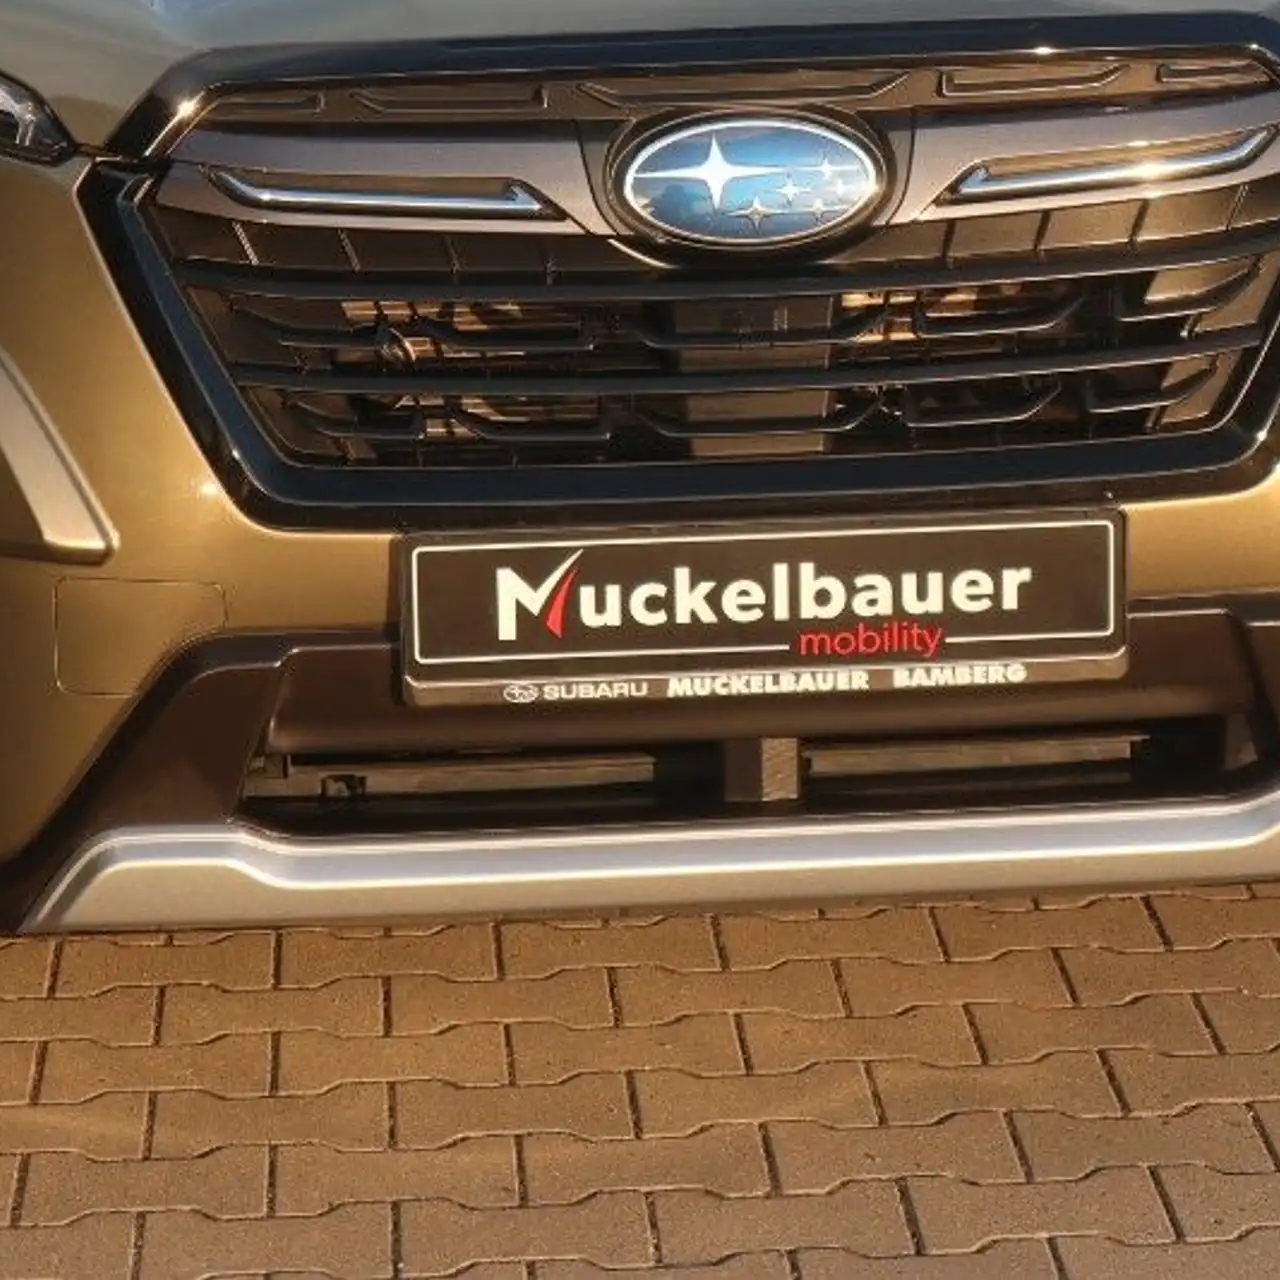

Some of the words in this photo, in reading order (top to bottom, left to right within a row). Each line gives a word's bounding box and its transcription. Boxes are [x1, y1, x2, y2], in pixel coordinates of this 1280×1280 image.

[496, 549, 1032, 641] Muckelbauer
[799, 622, 943, 658] mobility
[542, 681, 648, 700] SUBARU
[667, 670, 869, 698] MUCKELBAUER
[892, 663, 1028, 689] BAMBERG
